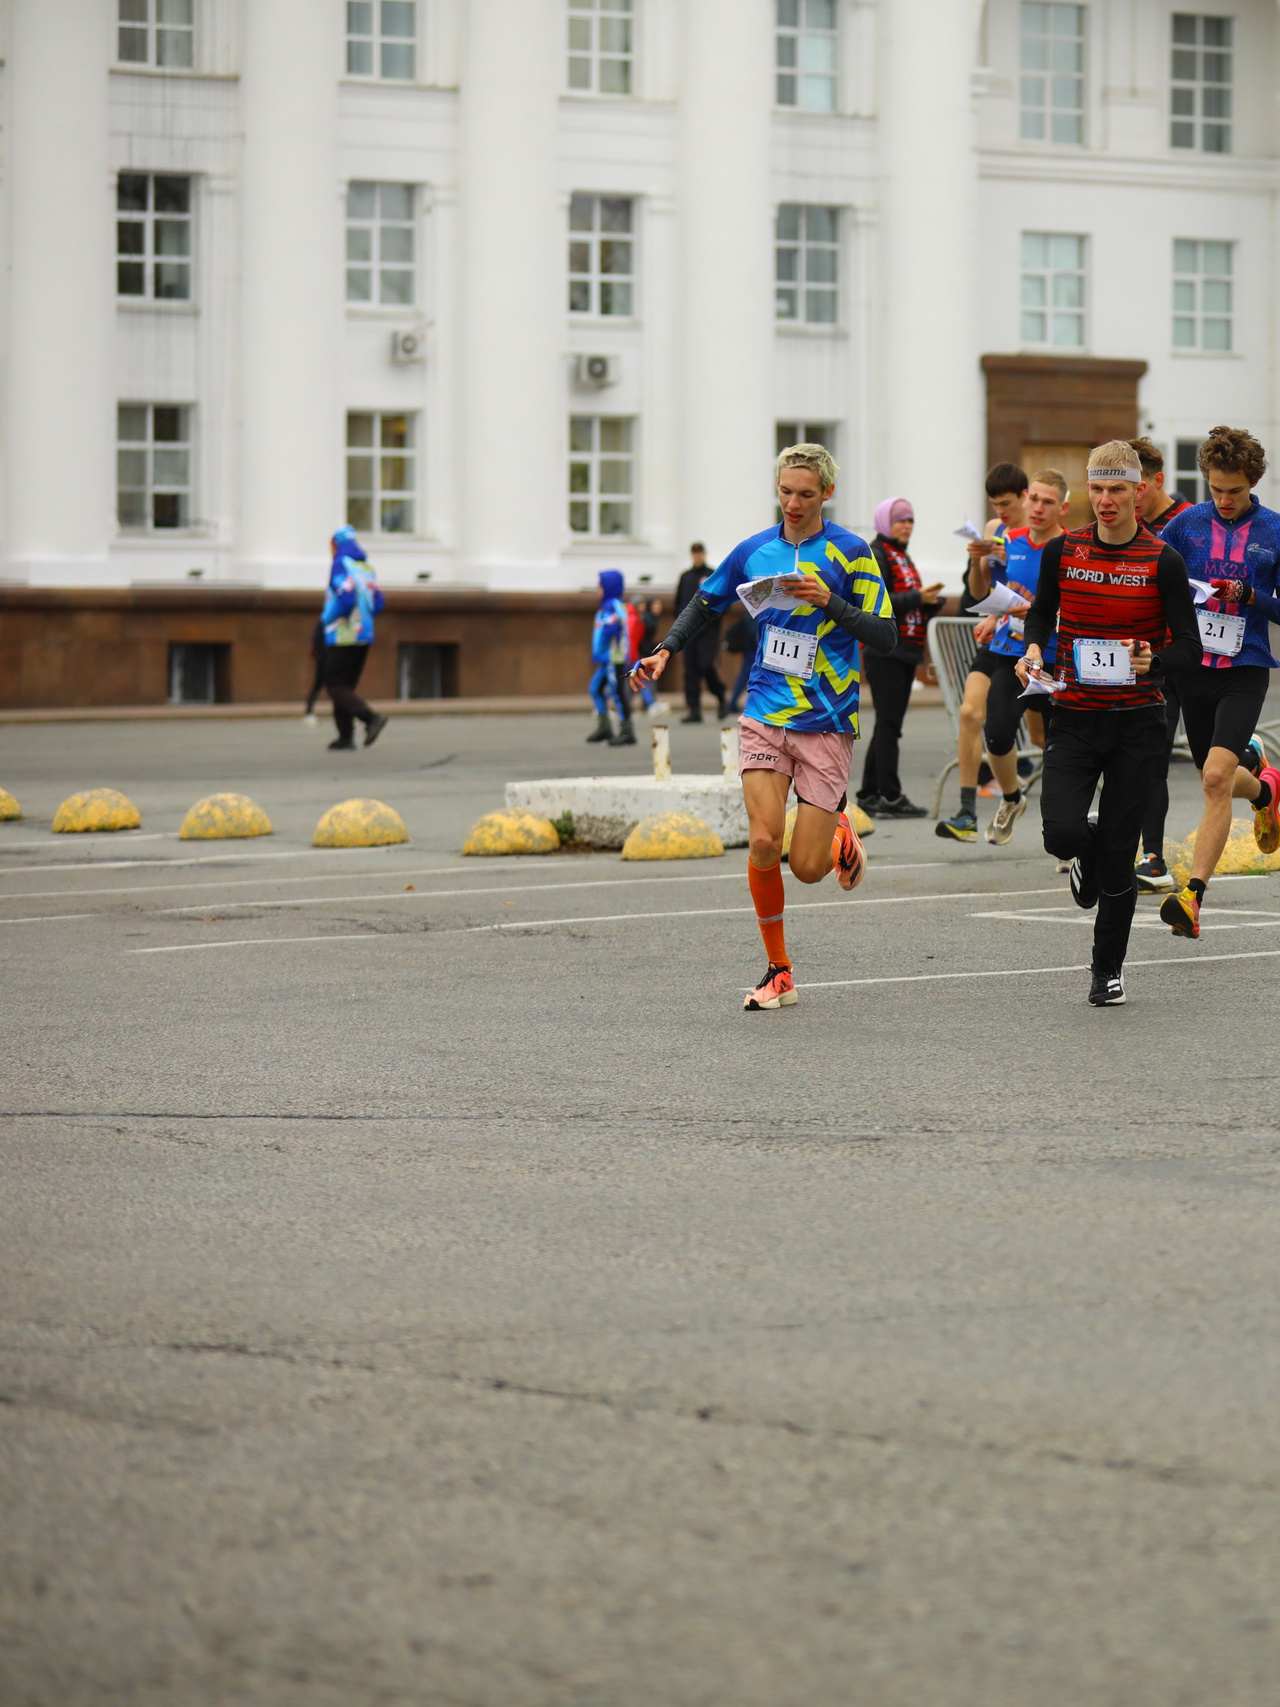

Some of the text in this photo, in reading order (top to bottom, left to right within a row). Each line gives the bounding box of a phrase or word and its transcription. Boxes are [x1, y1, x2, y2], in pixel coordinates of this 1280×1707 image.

[1066, 566, 1149, 587] NORD WEST
[1204, 622, 1225, 639] 2.1
[772, 639, 800, 659] 11.1
[1091, 651, 1116, 667] 3.1
[744, 753, 779, 762] SPORT
